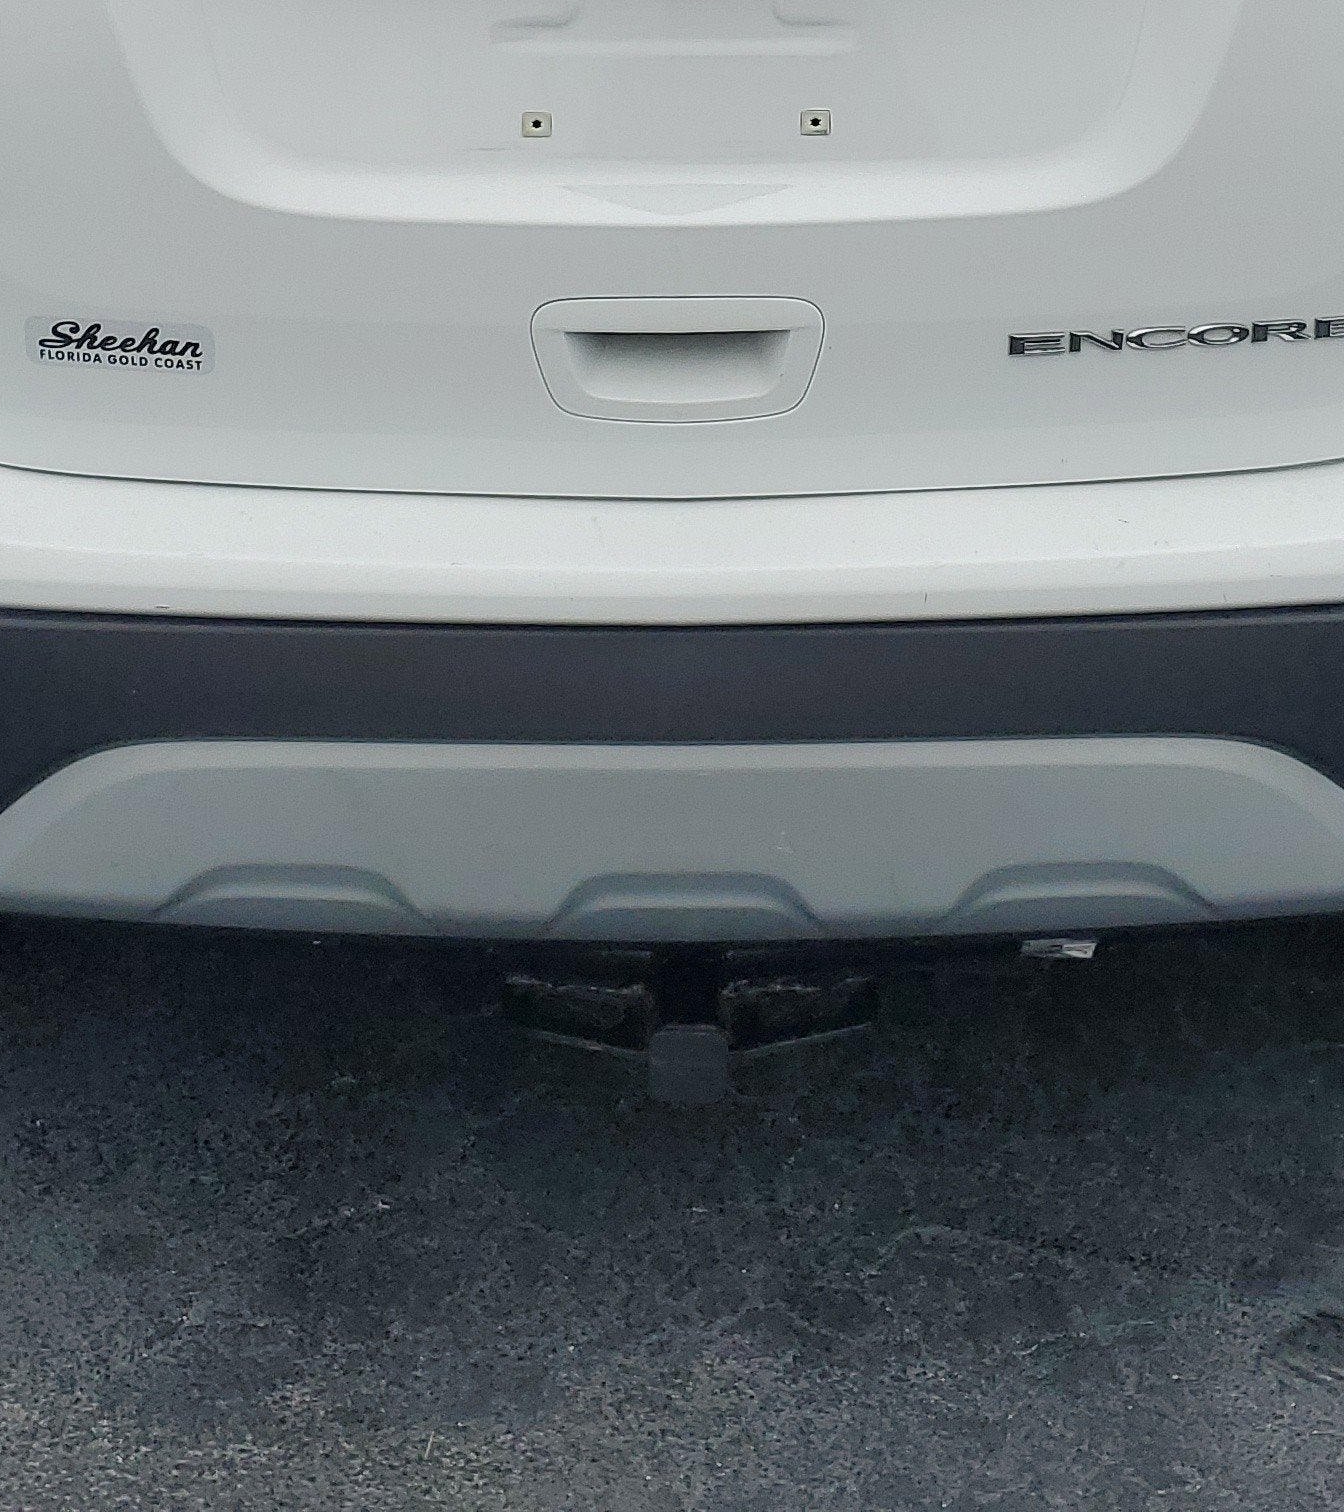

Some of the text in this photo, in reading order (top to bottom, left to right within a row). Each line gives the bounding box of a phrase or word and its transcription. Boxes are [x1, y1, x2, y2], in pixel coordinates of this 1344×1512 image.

[38, 321, 203, 356] Sheehan
[39, 349, 203, 371] FLORIDA GOLD COAST
